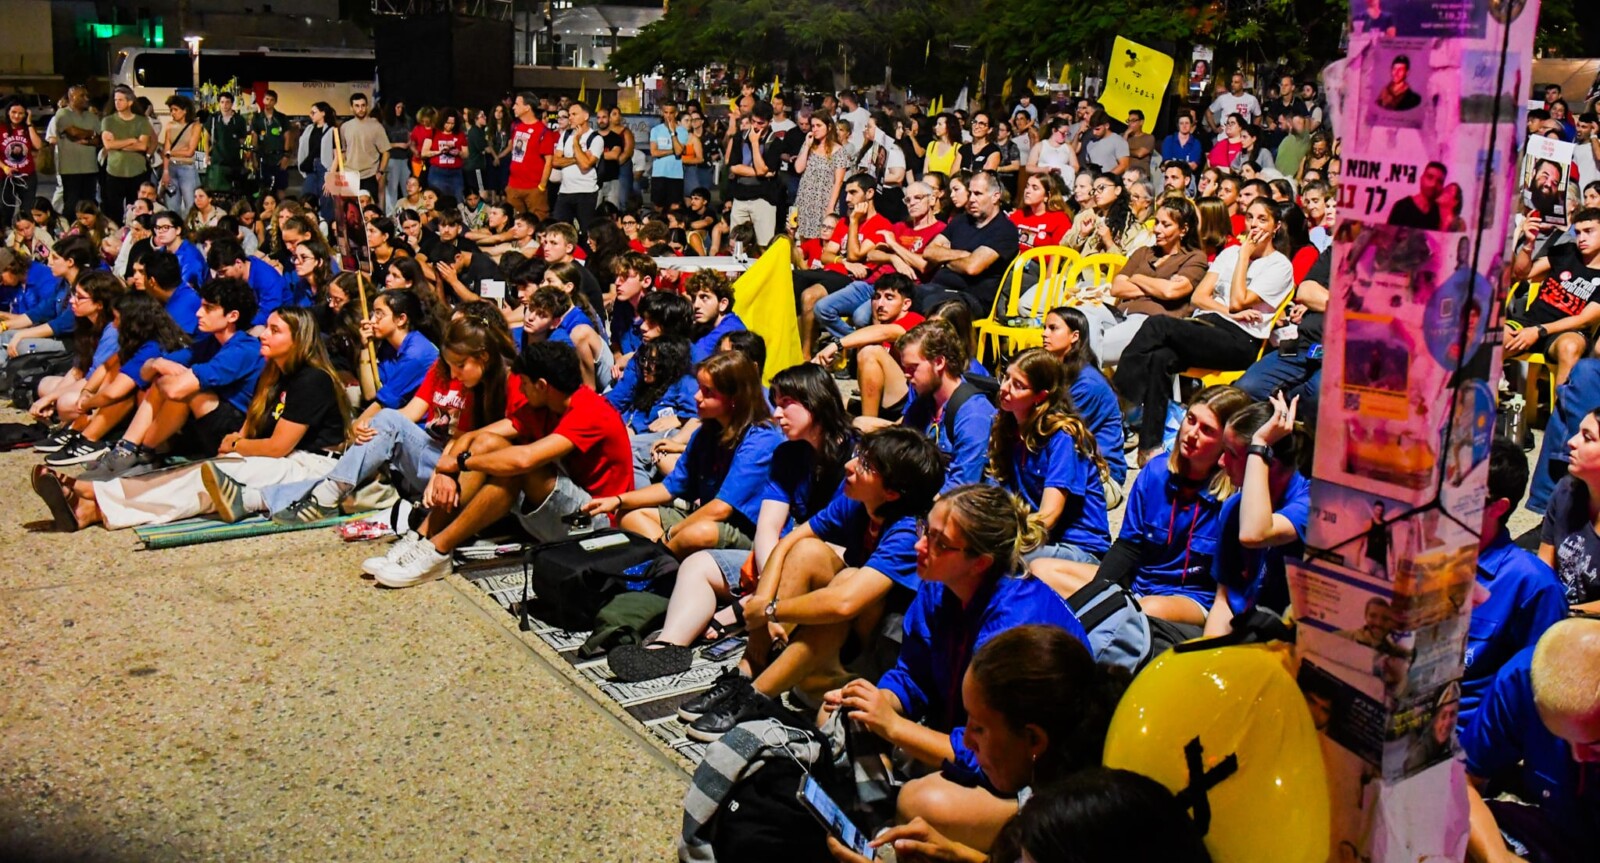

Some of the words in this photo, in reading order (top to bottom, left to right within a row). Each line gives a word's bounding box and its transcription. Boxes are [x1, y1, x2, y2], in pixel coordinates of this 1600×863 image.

[1346, 159, 1381, 180] אמא
[1384, 163, 1417, 184] גיא,
[1365, 186, 1388, 215] לך
